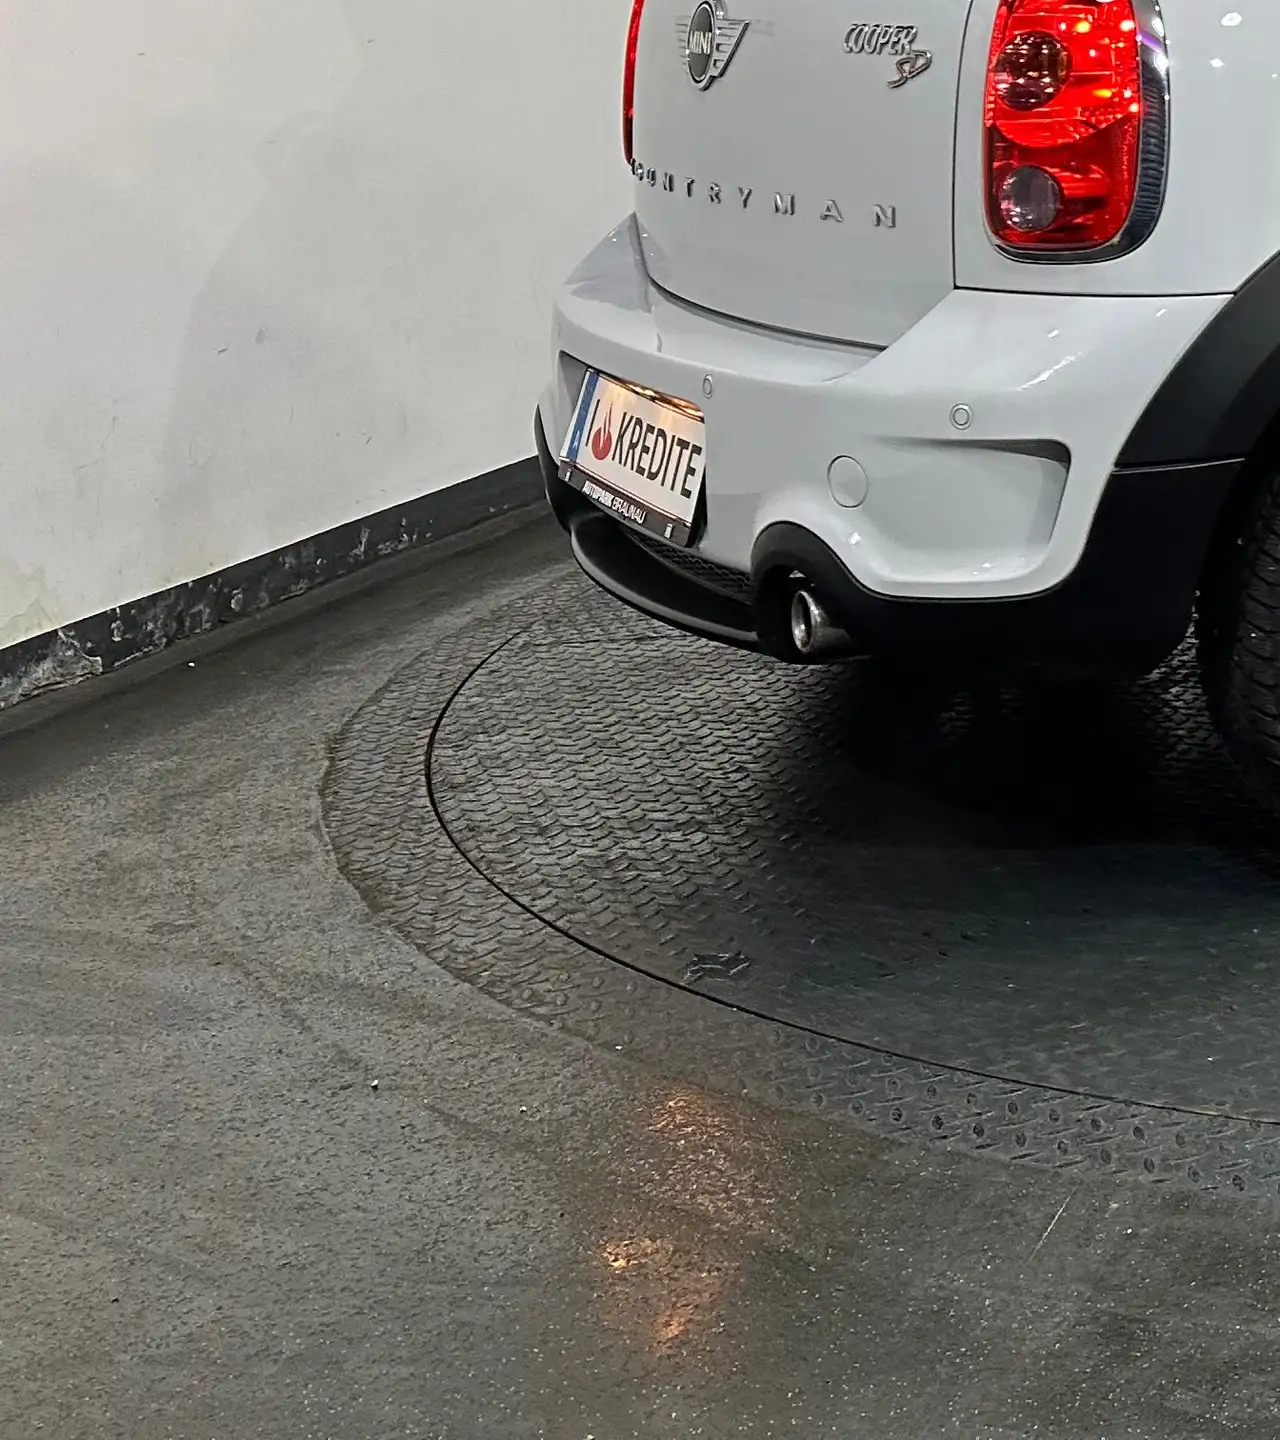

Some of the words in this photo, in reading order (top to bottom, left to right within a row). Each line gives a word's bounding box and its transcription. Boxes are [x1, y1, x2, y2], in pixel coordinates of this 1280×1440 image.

[687, 30, 713, 56] MINI
[843, 23, 918, 56] COOPER
[611, 411, 703, 499] KREDITE
